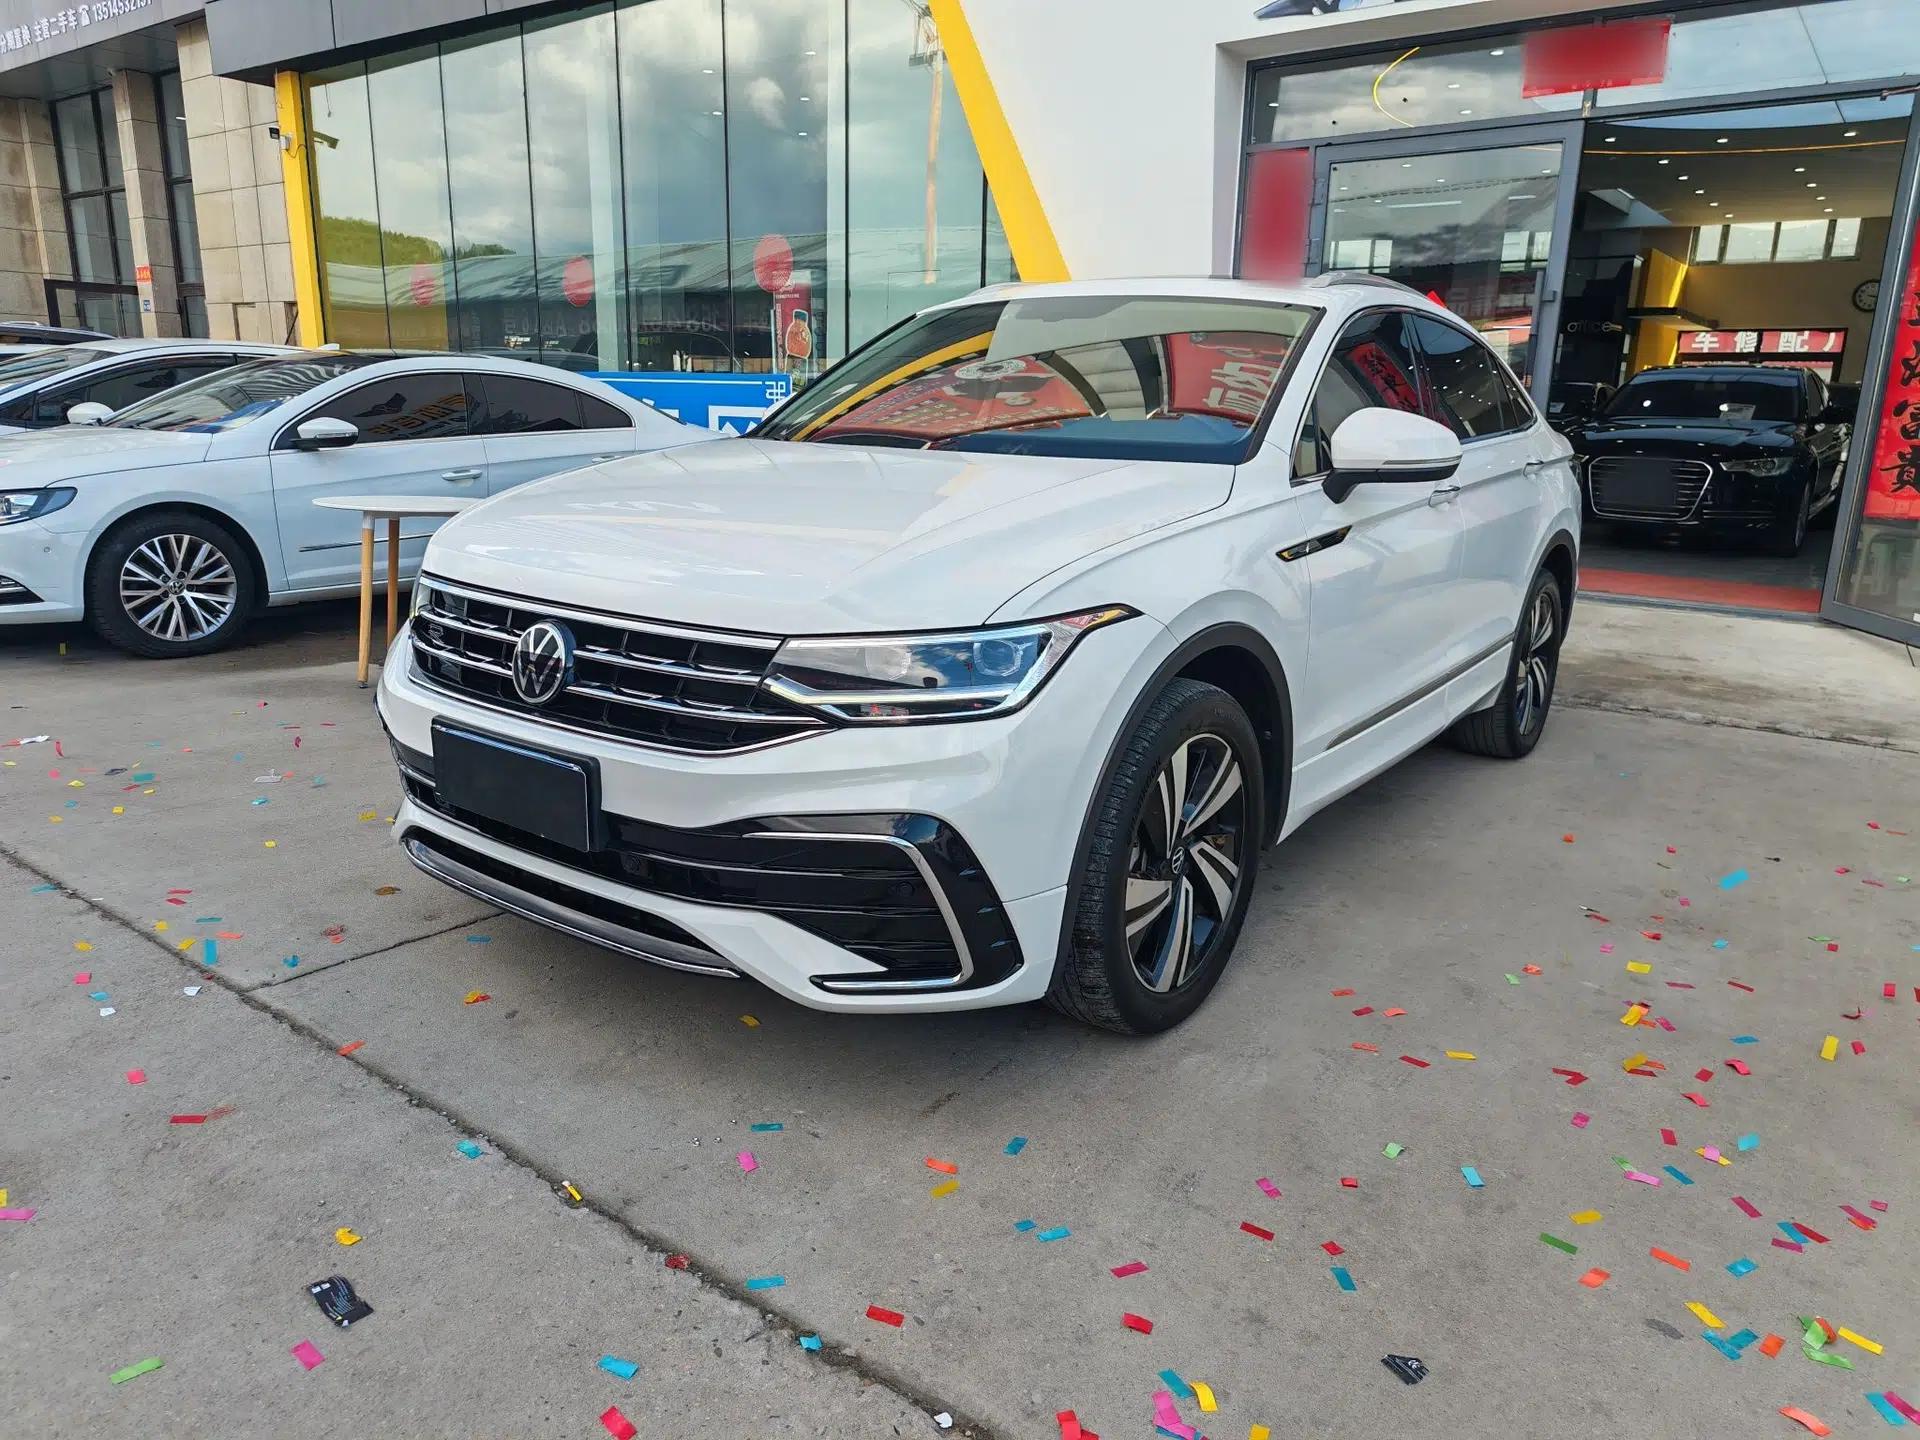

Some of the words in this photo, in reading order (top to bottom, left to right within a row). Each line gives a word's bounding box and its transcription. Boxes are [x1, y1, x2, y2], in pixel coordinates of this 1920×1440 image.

[34, 8, 78, 42] 主营二手车
[92, 0, 153, 22] 13514532
